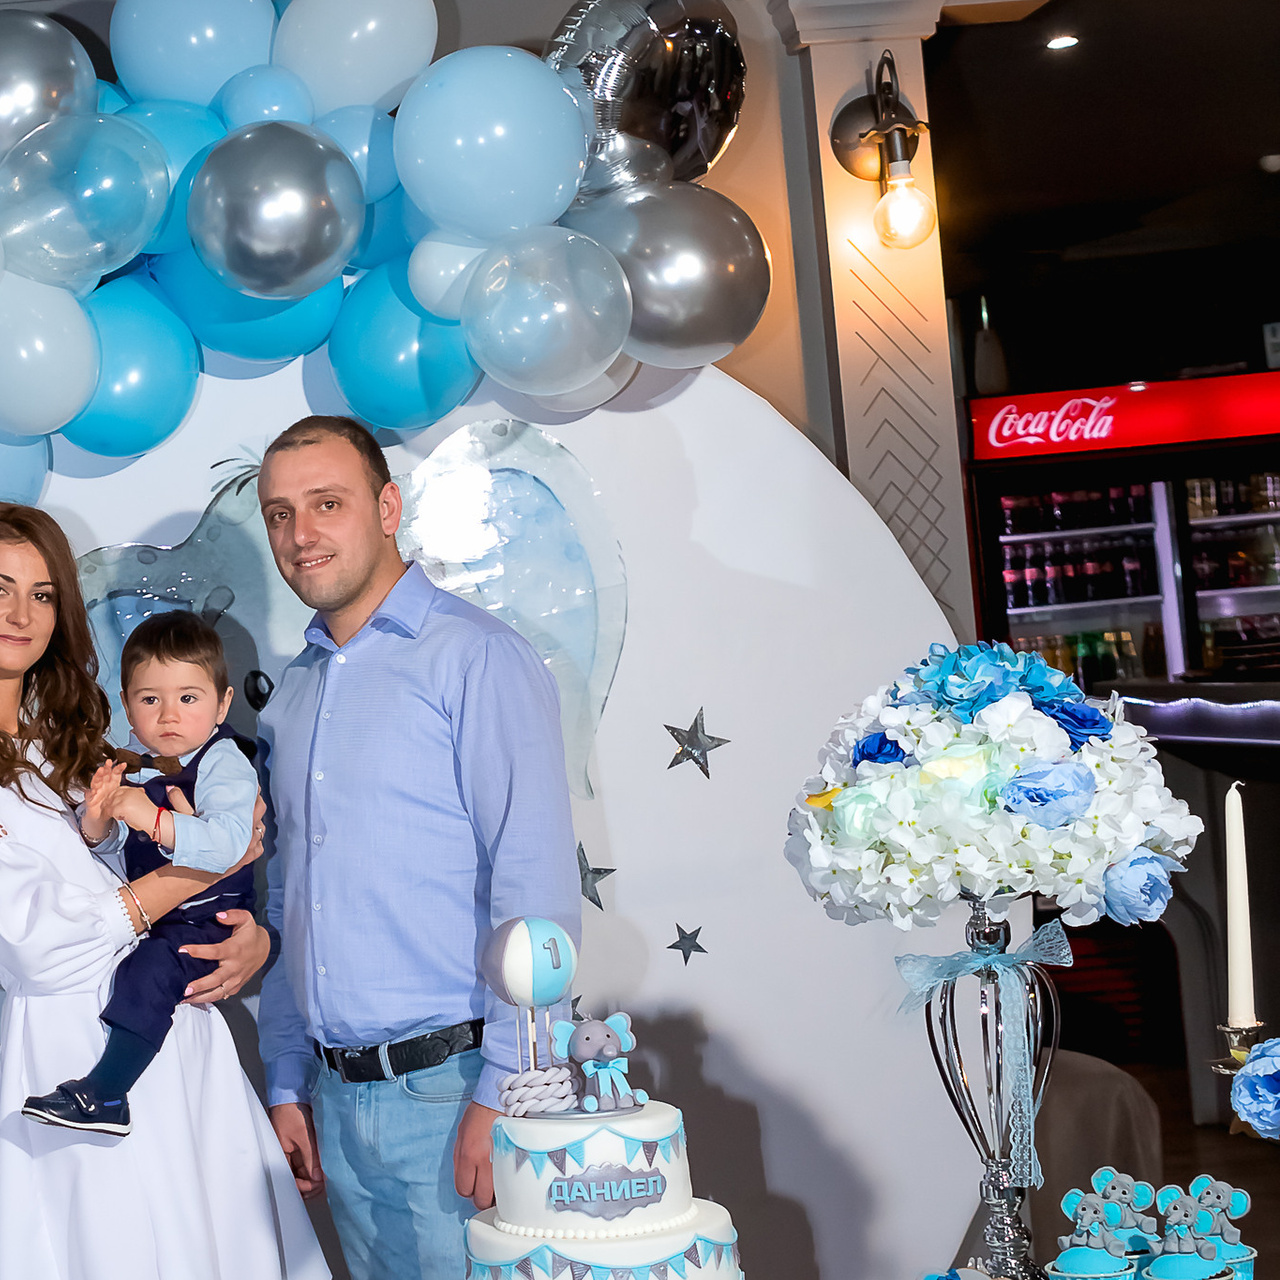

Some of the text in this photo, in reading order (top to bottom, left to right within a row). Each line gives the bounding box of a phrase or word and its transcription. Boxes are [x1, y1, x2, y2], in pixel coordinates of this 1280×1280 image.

[988, 395, 1118, 448] Coca-Cola
[542, 937, 562, 970] 1
[550, 1176, 663, 1205] ДАНИЕЛ
